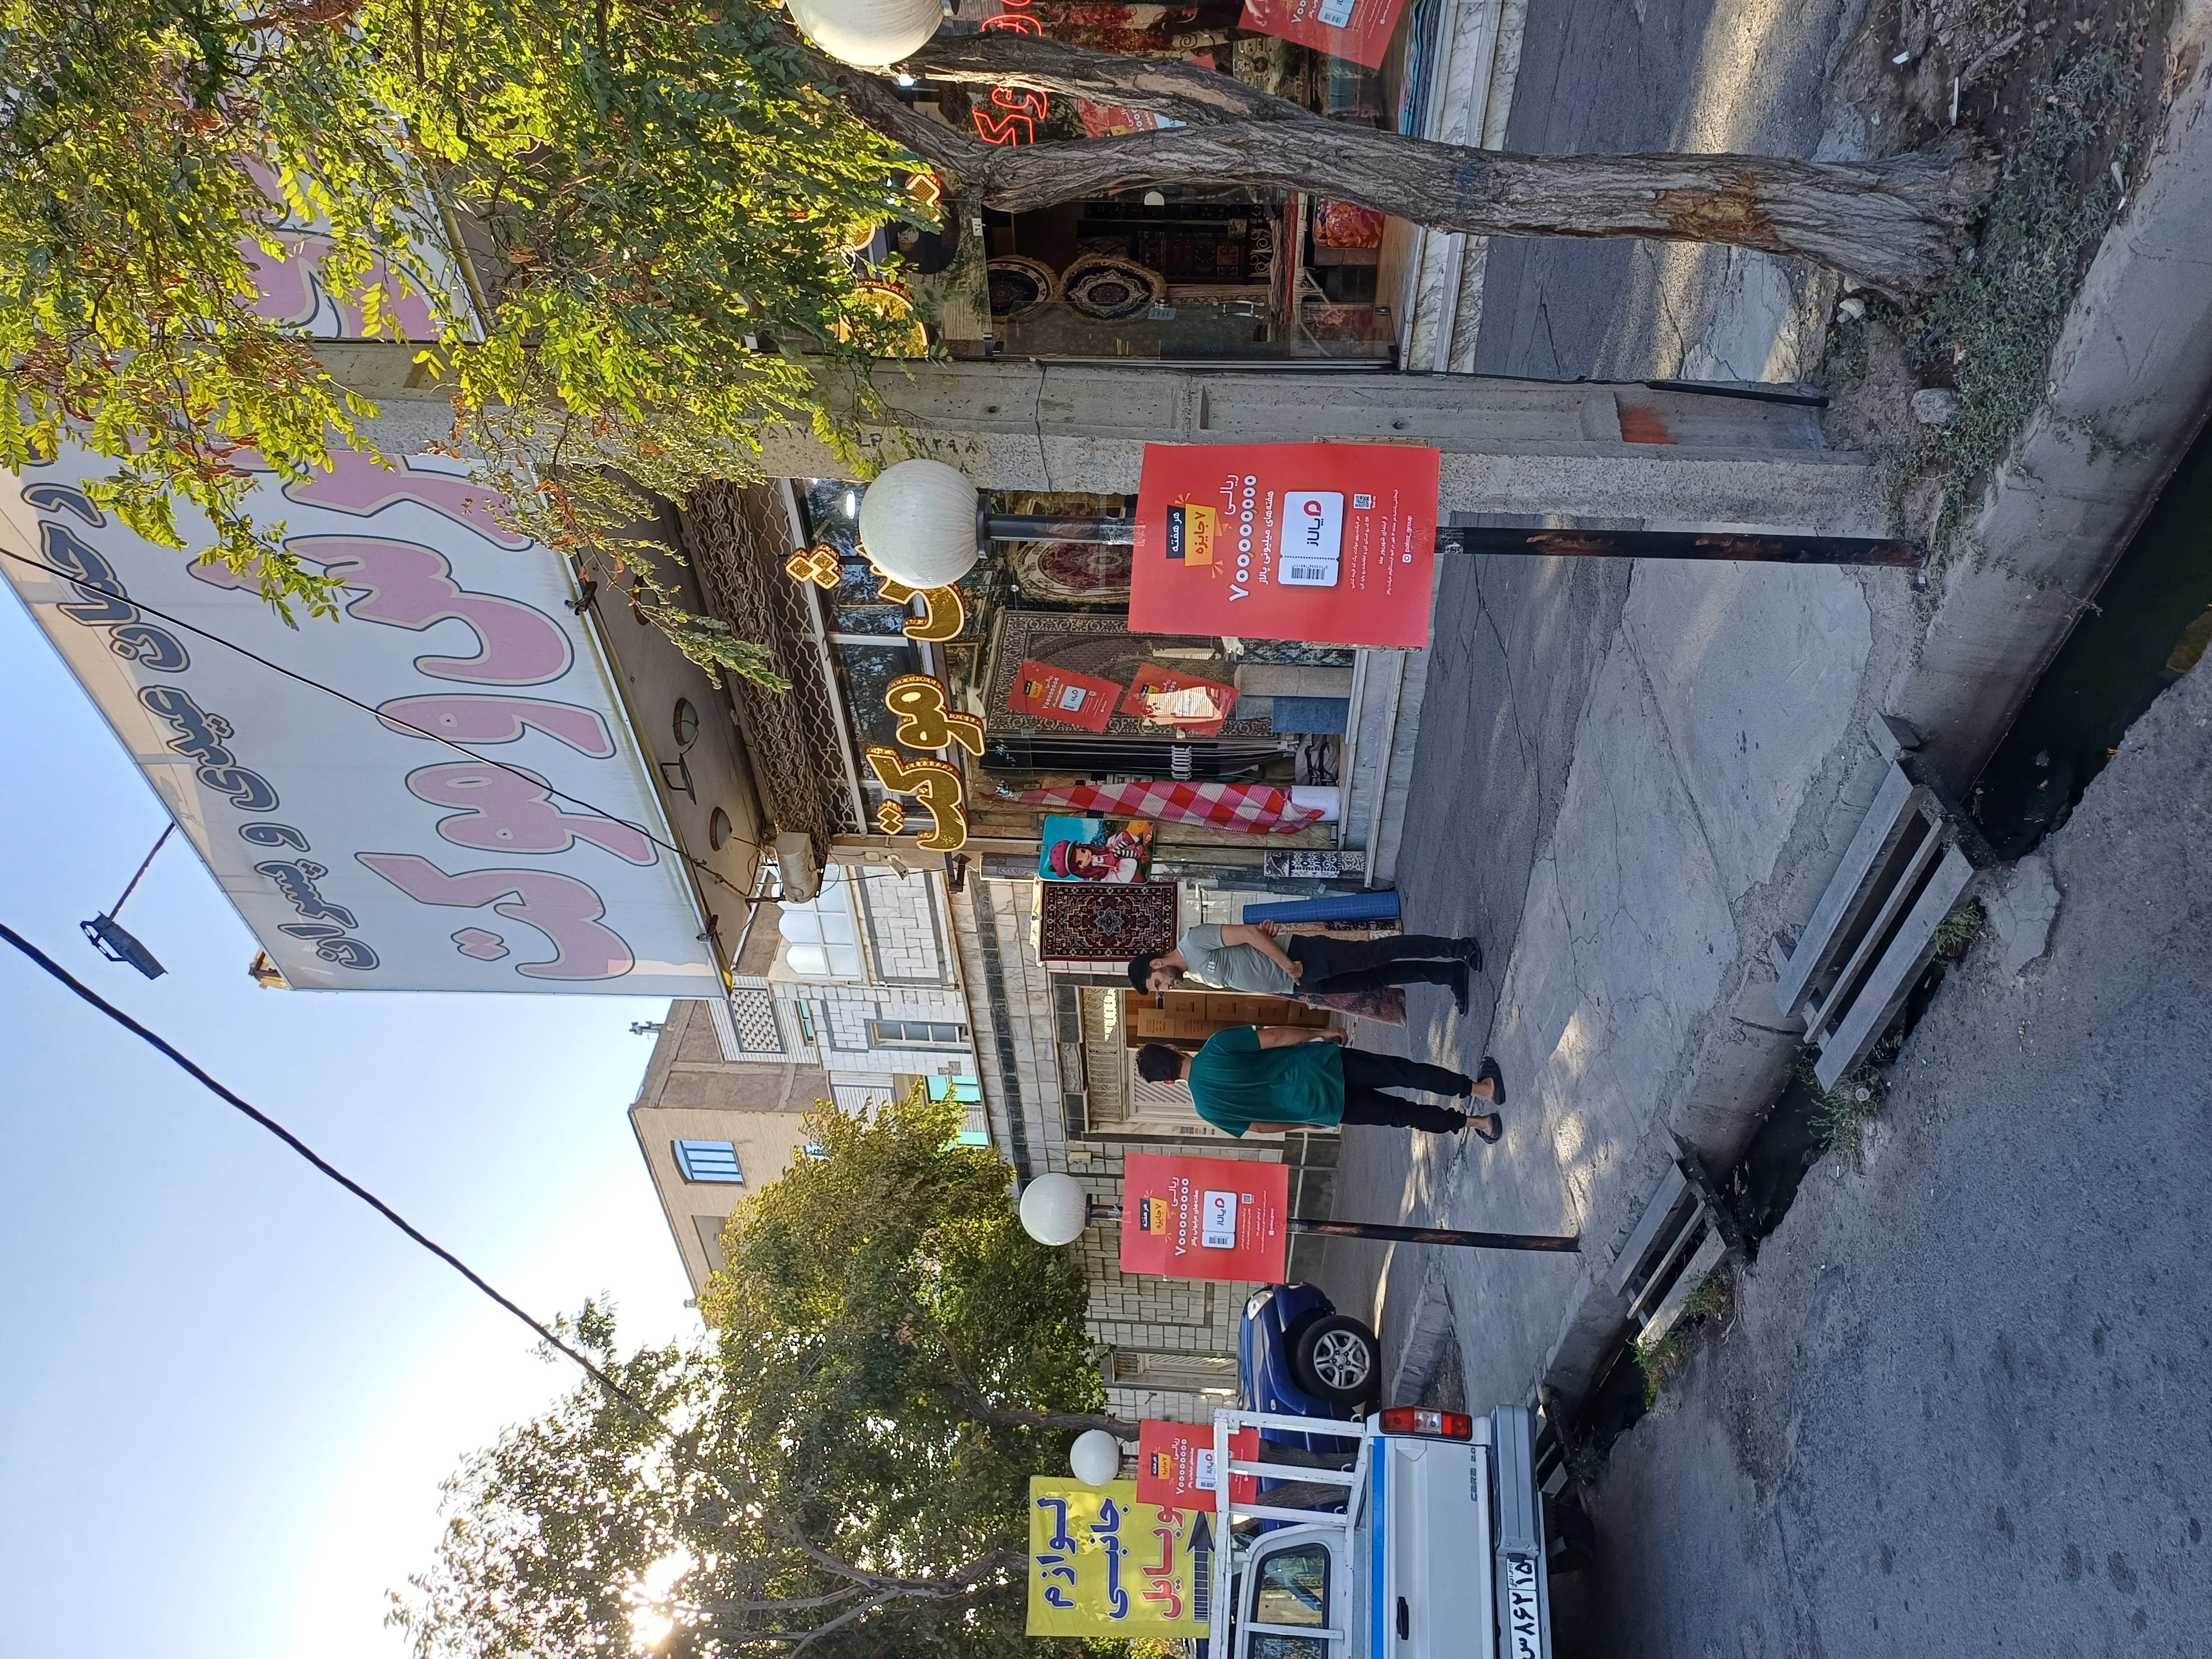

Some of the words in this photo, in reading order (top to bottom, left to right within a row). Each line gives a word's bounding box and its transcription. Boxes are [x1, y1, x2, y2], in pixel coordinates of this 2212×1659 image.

[1219, 474, 1239, 515] ریالی
[1172, 512, 1182, 524] هر
[1194, 511, 1206, 520] ۷
[1307, 518, 1324, 546] پالاز
[1170, 525, 1180, 552] هفته
[1193, 521, 1209, 554] جایزه
[1261, 530, 1272, 564] میلیونی
[1404, 515, 1413, 552] palaz_group
[20, 483, 191, 672] رحمان
[1259, 566, 1271, 585] پالاز
[374, 692, 616, 758] و
[137, 685, 280, 811] عیدی
[865, 674, 985, 852] موکت
[238, 822, 311, 852] و
[354, 758, 660, 980] موکت
[254, 859, 379, 971] پسران
[1168, 1177, 1179, 1207] ریالی
[1171, 1437, 1180, 1460] ریالی
[1034, 1496, 1077, 1609] لوازم
[1089, 1496, 1129, 1620] جانبی
[1141, 1505, 1183, 1619] وبایل
[1514, 1562, 1533, 1586] ۱۵
